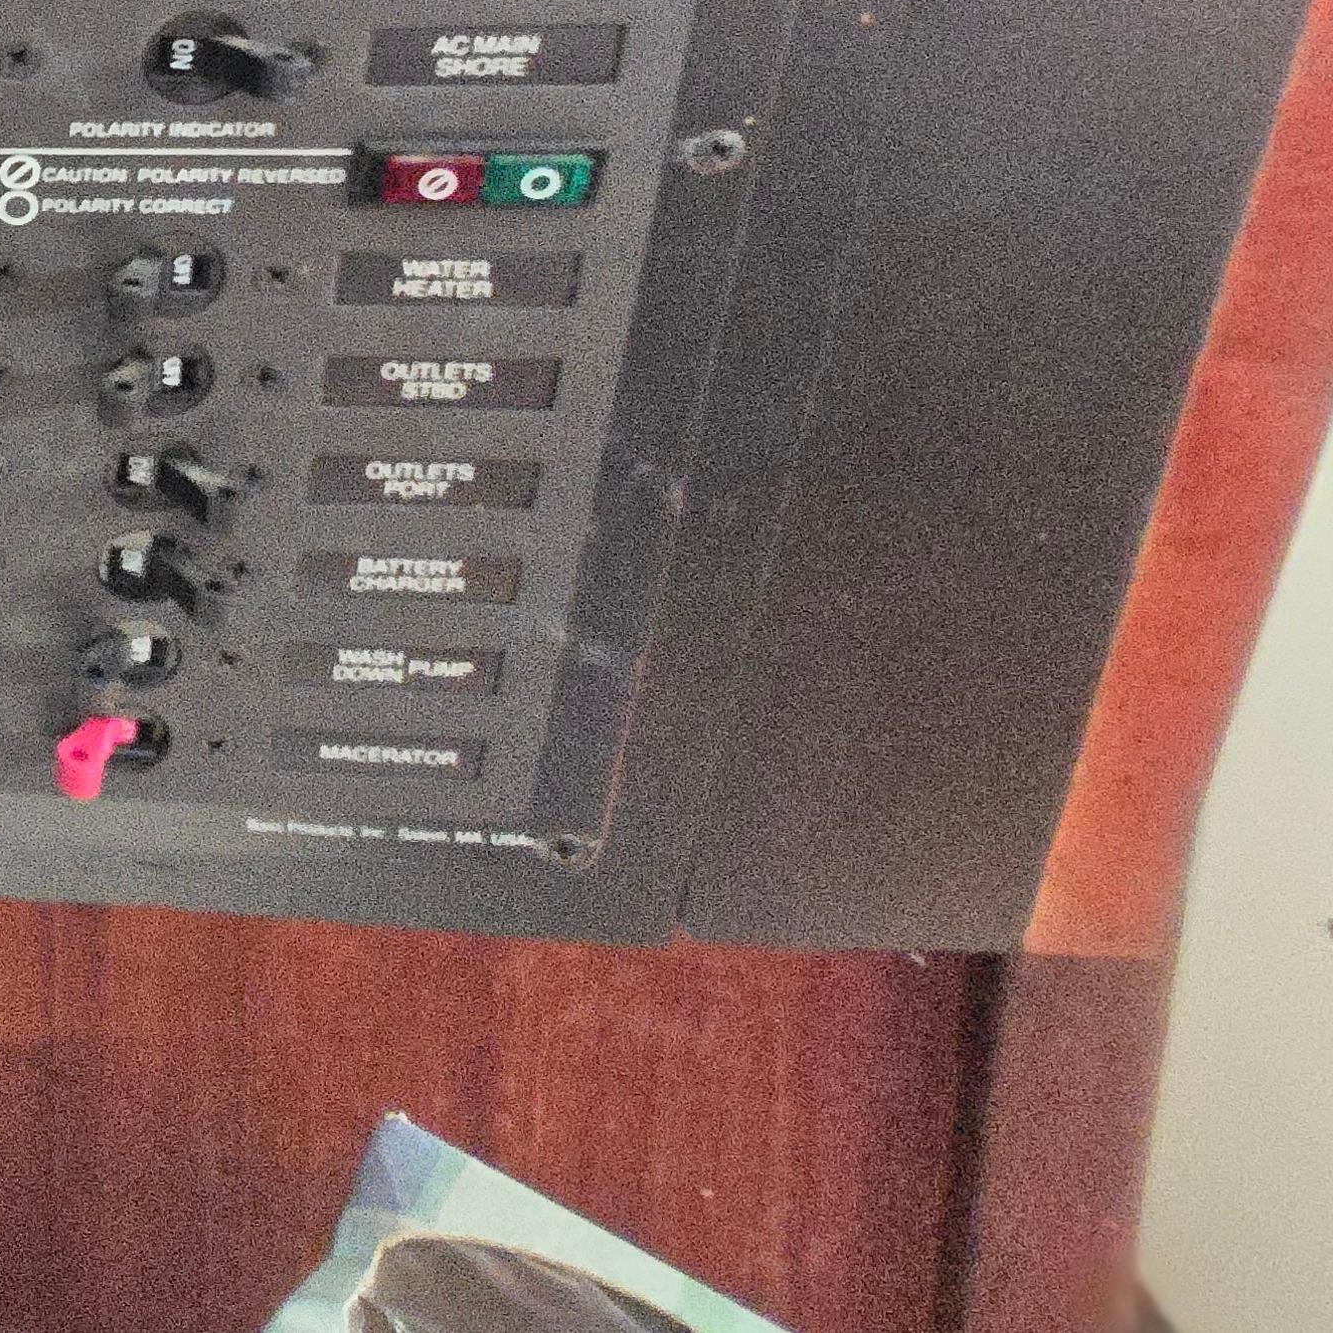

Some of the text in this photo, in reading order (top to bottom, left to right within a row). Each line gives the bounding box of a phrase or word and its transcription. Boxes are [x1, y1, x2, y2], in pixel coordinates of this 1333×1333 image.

[170, 39, 195, 69] ON
[432, 33, 540, 57] AC MAIN
[436, 55, 530, 78] SHORE
[69, 120, 276, 140] POLARITY INDICATOR
[137, 167, 233, 185] POLARITY
[237, 167, 347, 186] REVERSED
[42, 198, 233, 216] POLARITY CORRECT
[401, 258, 491, 279] WATER
[393, 278, 493, 299] HEATER
[380, 361, 492, 383] OUTLETS
[401, 381, 467, 402] STBD
[365, 461, 475, 482] OUTLETS
[383, 478, 450, 498] PORT
[356, 557, 464, 579] BATTERY
[349, 574, 466, 593] CHARGER
[338, 649, 404, 667] WASH
[333, 664, 402, 683] DOWN
[408, 660, 477, 679] PUMP
[318, 744, 458, 767] MACERATOR
